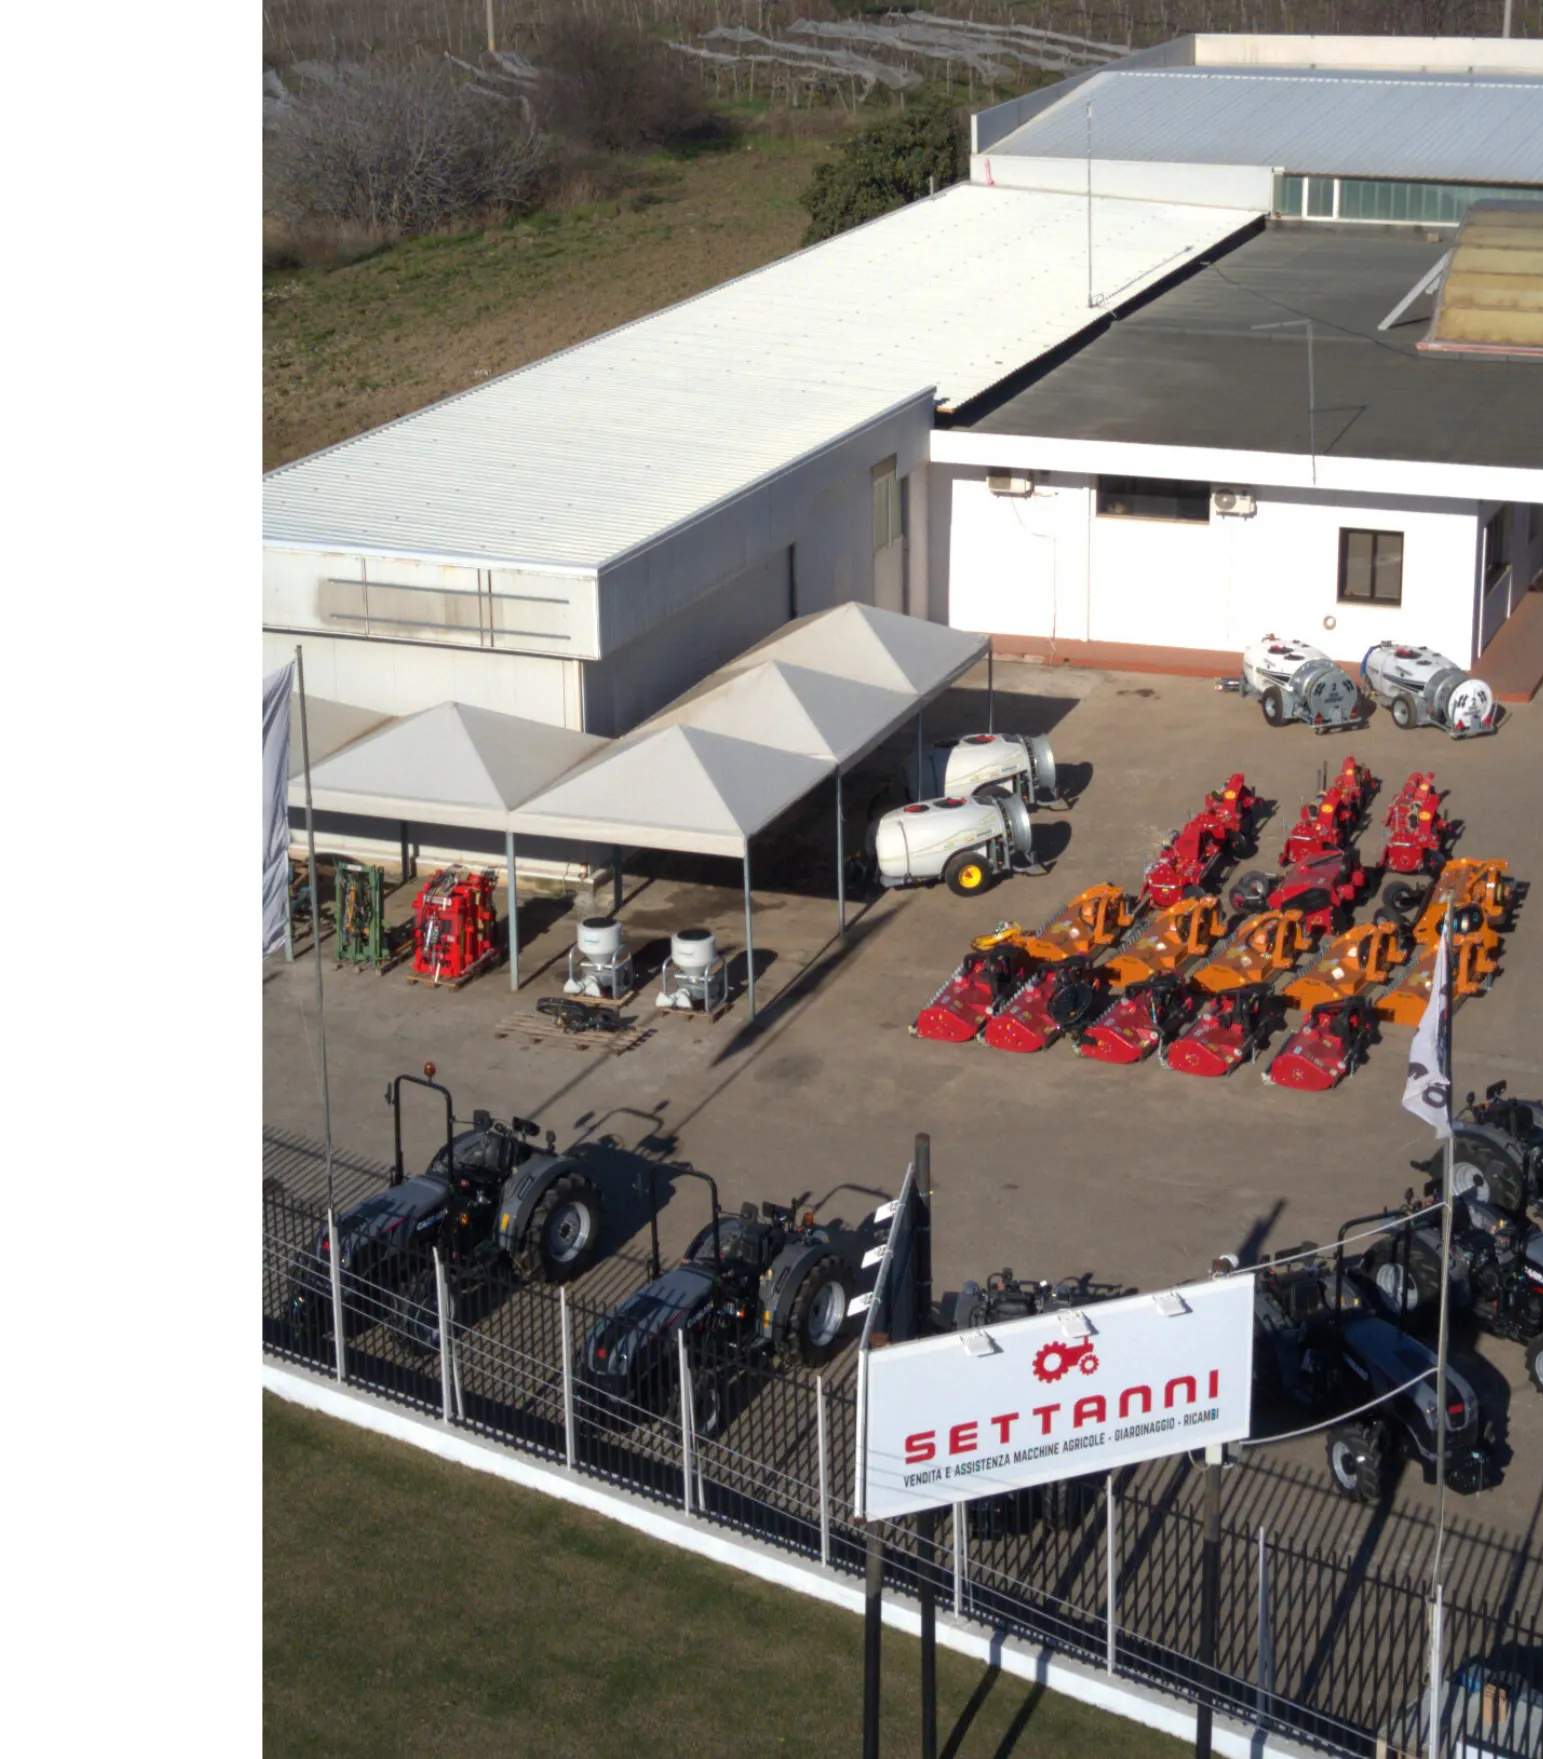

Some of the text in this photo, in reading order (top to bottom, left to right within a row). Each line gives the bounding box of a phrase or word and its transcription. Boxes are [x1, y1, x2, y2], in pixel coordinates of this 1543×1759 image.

[904, 1470, 942, 1488] VENDITA
[945, 1466, 952, 1479] E
[954, 1454, 1011, 1477] ASSISTENZA
[1013, 1442, 1060, 1464] MACCHINE
[1062, 1432, 1106, 1454] AGRICOLE
[1114, 1417, 1175, 1442] GIARDINAGGIO
[1183, 1408, 1220, 1428] RICAMBI
